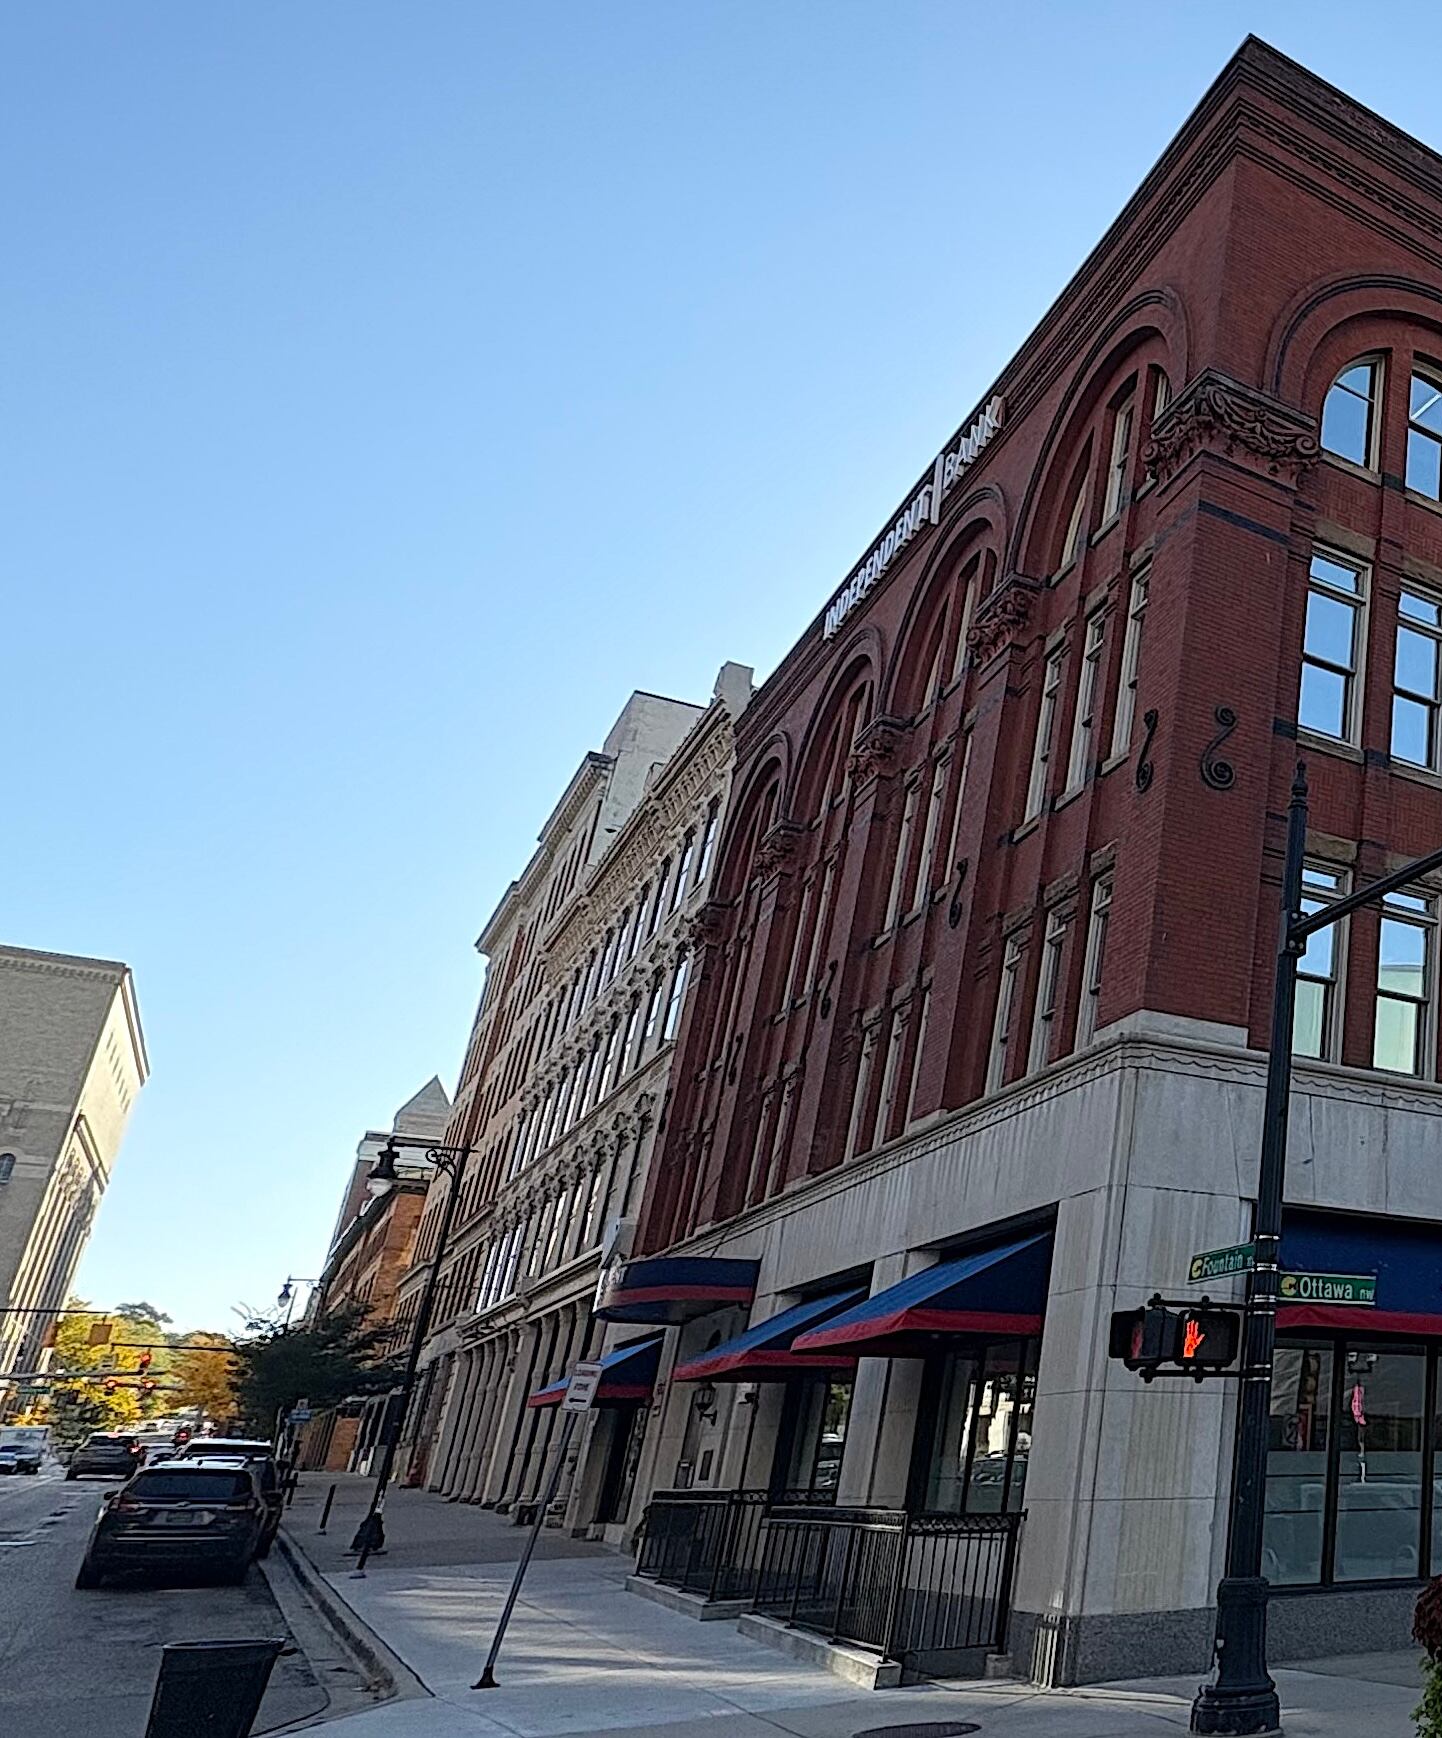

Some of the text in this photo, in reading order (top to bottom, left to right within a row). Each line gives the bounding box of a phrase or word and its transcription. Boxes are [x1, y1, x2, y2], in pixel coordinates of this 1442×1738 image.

[943, 395, 1004, 491] BANK
[1201, 1253, 1244, 1277] Fountain
[1300, 1276, 1353, 1300] Ottawa
